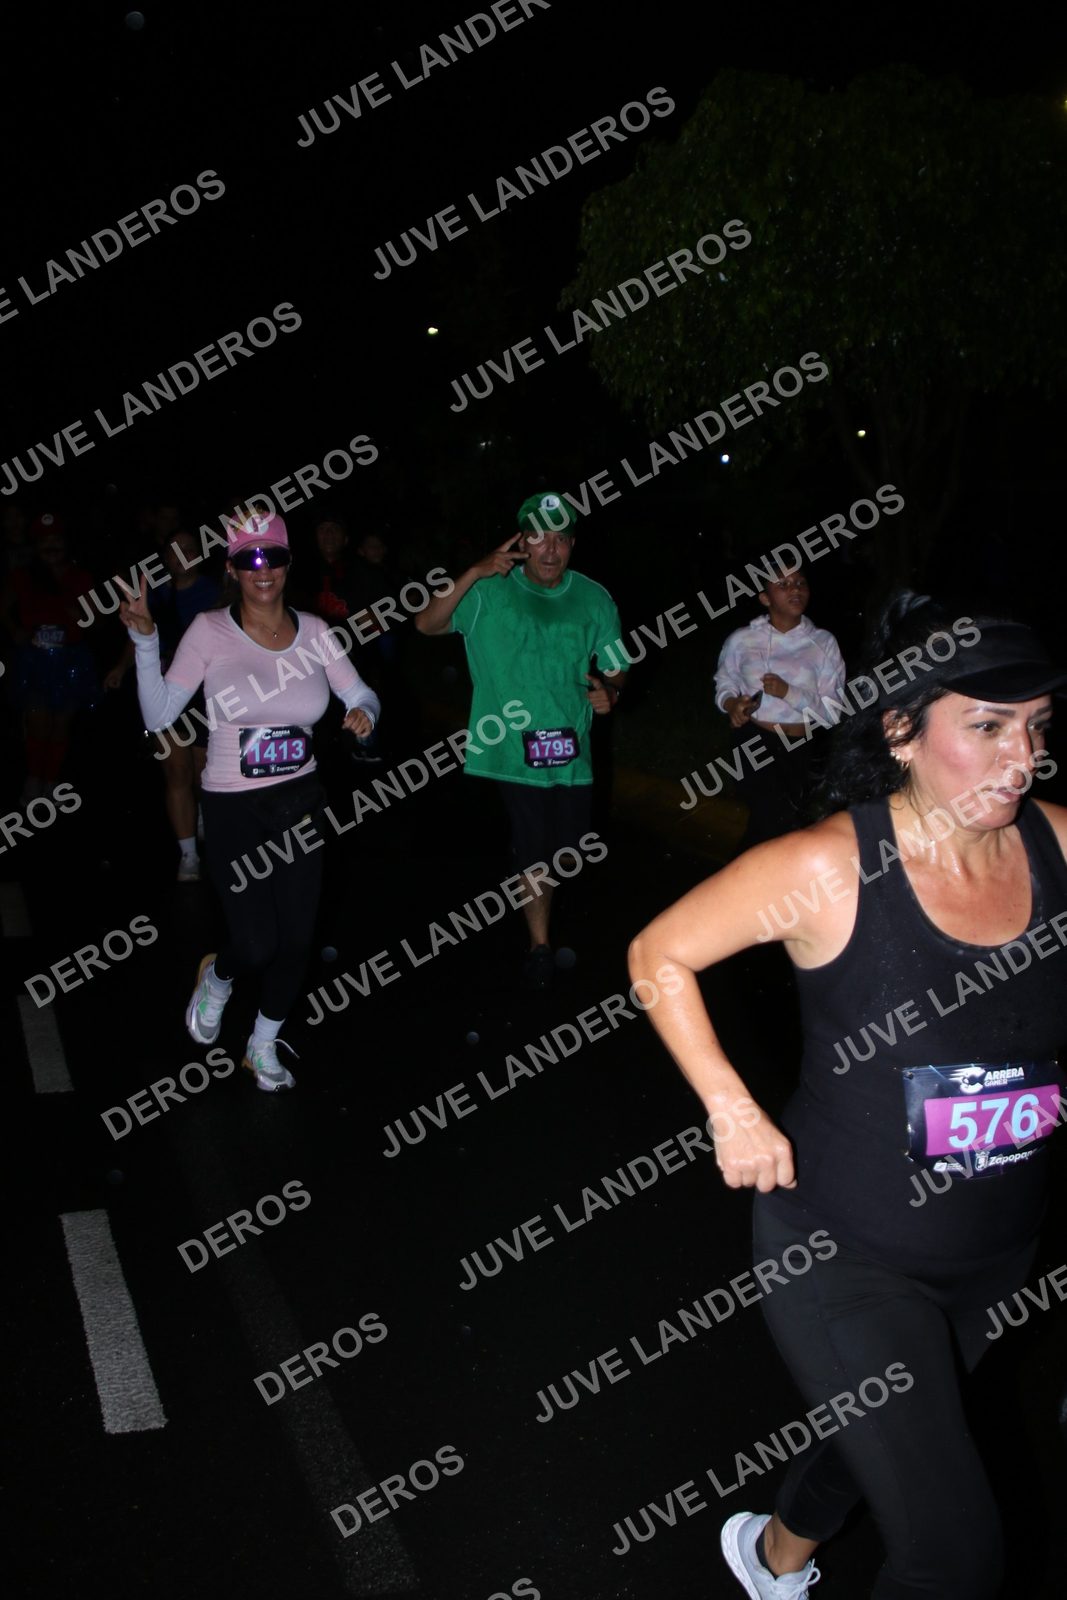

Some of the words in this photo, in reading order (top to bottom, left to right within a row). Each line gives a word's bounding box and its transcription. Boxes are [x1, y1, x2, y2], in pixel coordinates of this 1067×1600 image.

[250, 739, 304, 763] 1413
[531, 738, 575, 758] 1795
[948, 1093, 1040, 1149] 576
